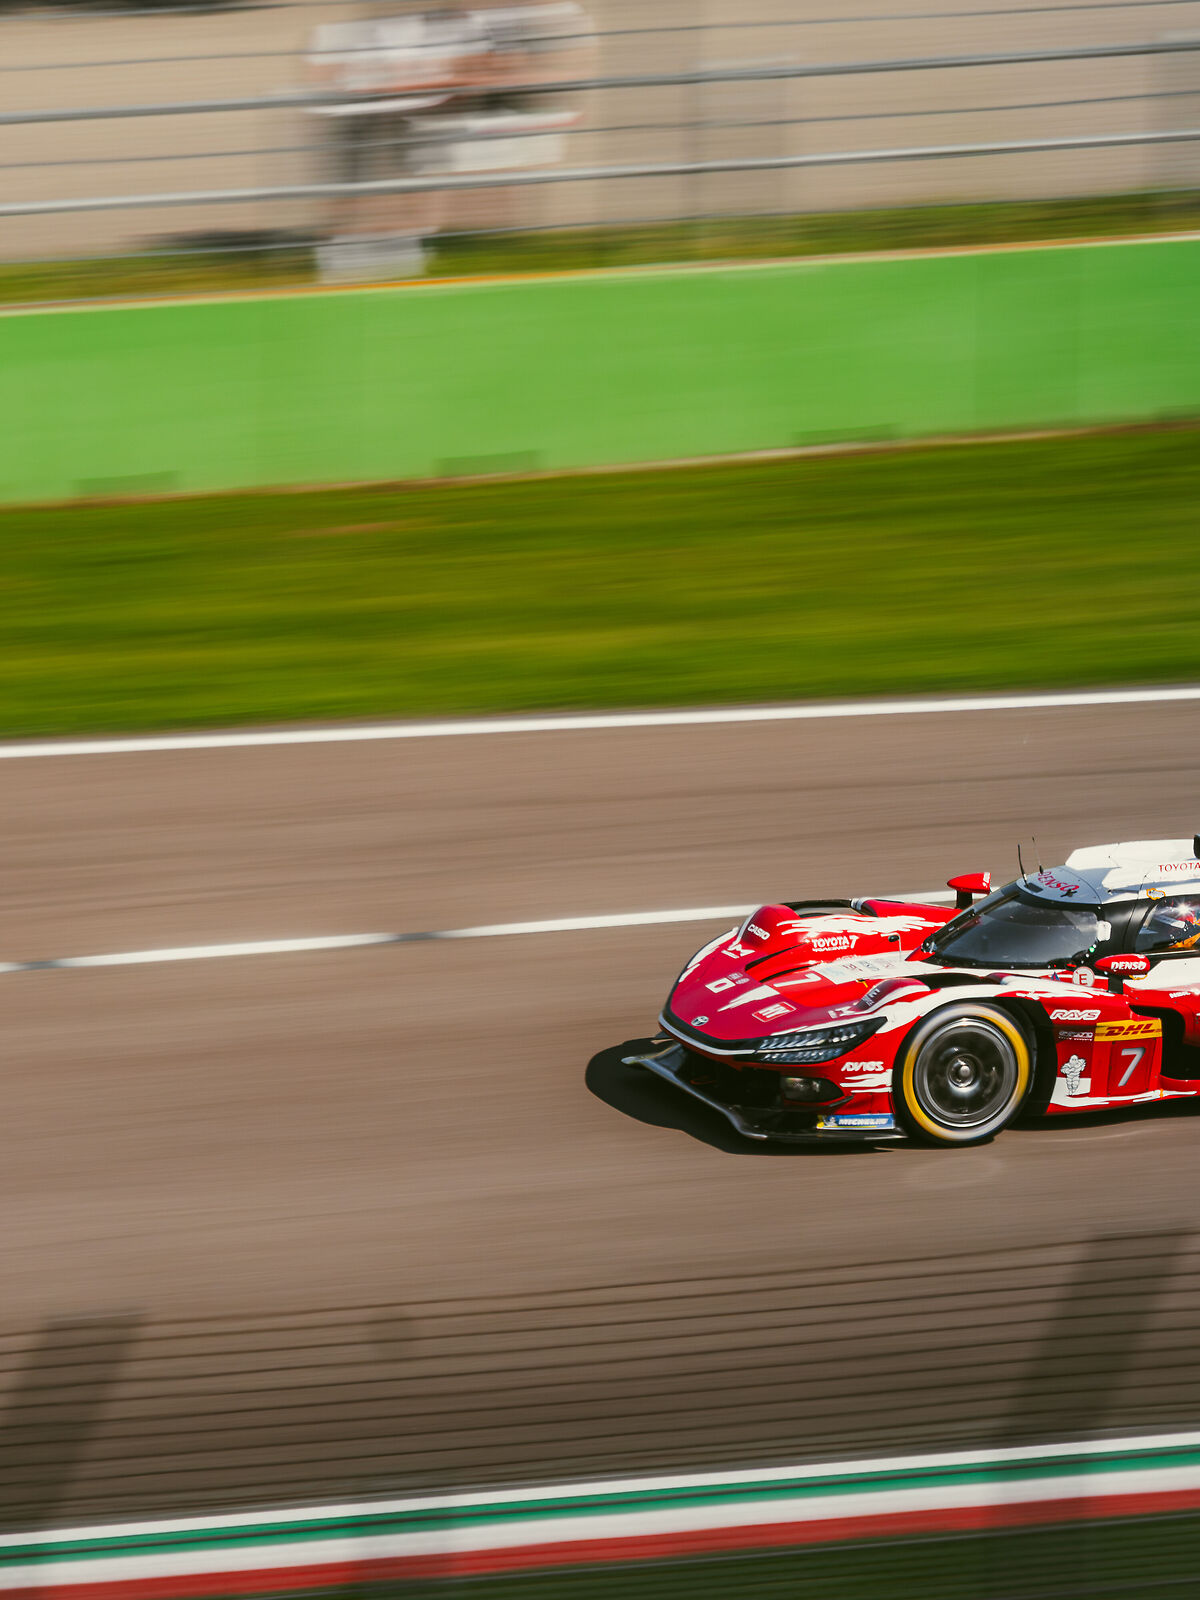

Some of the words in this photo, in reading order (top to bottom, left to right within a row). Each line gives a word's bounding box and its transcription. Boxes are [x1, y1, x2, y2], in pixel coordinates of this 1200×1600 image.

[747, 923, 771, 941] CASIO
[812, 936, 850, 948] TOYOTA
[1110, 960, 1147, 971] DENSO
[1079, 973, 1088, 986] E
[1049, 1009, 1102, 1020] RAYS
[1105, 1023, 1155, 1037] DHL
[1118, 1046, 1146, 1087] 7
